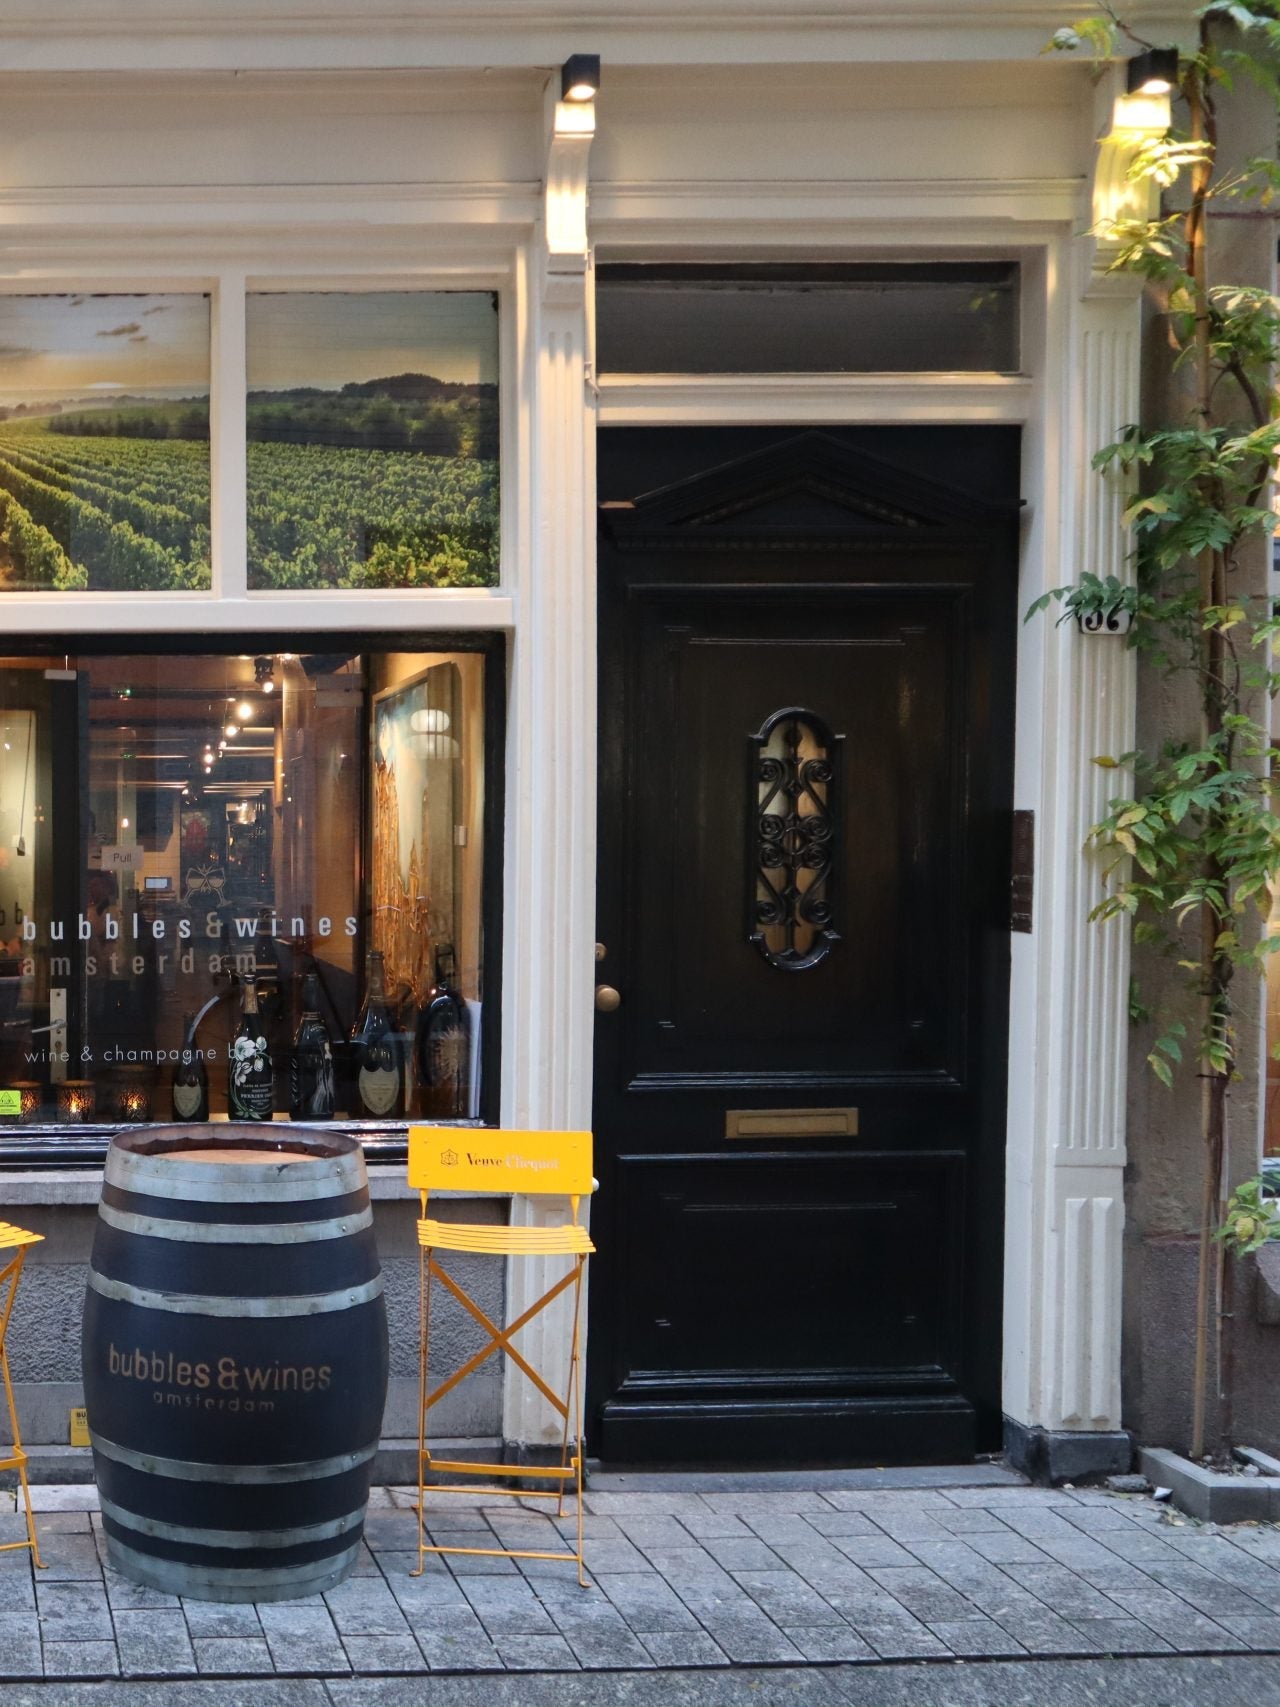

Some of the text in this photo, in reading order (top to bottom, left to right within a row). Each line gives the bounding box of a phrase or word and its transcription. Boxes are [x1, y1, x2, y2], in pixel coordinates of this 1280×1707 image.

[113, 852, 132, 863] Pull
[22, 912, 191, 941] bubbles
[235, 911, 358, 938] wines
[22, 947, 257, 977] amsterdam
[24, 1048, 70, 1063] wine
[80, 1045, 94, 1062] &
[103, 1044, 217, 1065] champagne
[466, 1152, 561, 1174] Veuve Clicquot
[108, 1342, 211, 1389] bubbles
[244, 1359, 332, 1392] wines
[152, 1391, 275, 1412] amsterdam
